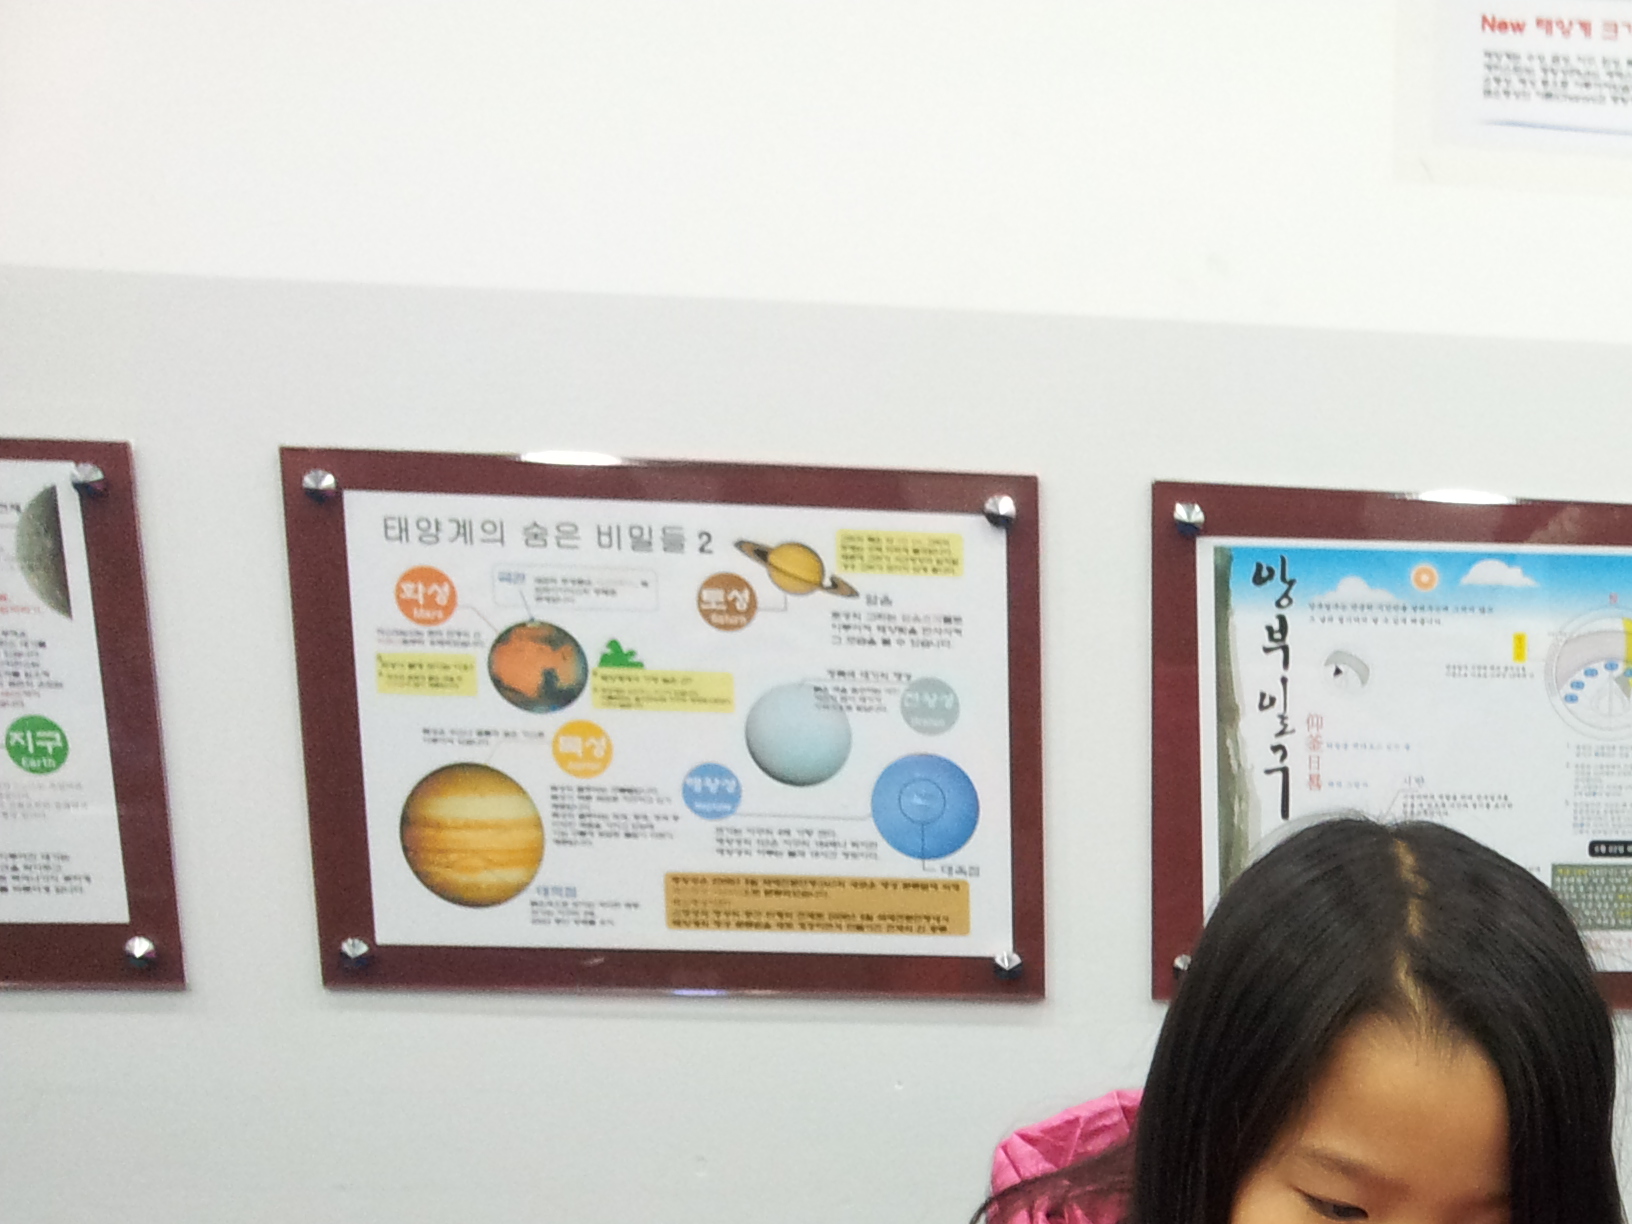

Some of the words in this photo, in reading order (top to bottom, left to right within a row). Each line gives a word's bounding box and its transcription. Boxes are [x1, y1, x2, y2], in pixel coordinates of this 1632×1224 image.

[383, 516, 506, 547] 태양계의
[523, 521, 581, 550] 숨은
[597, 524, 685, 554] 비밀들
[698, 531, 714, 554] 2
[399, 580, 450, 607] 화성
[700, 588, 750, 612] 토성
[10, 730, 63, 755] 지구
[559, 736, 609, 758] 목성
[22, 757, 56, 768] Earth
